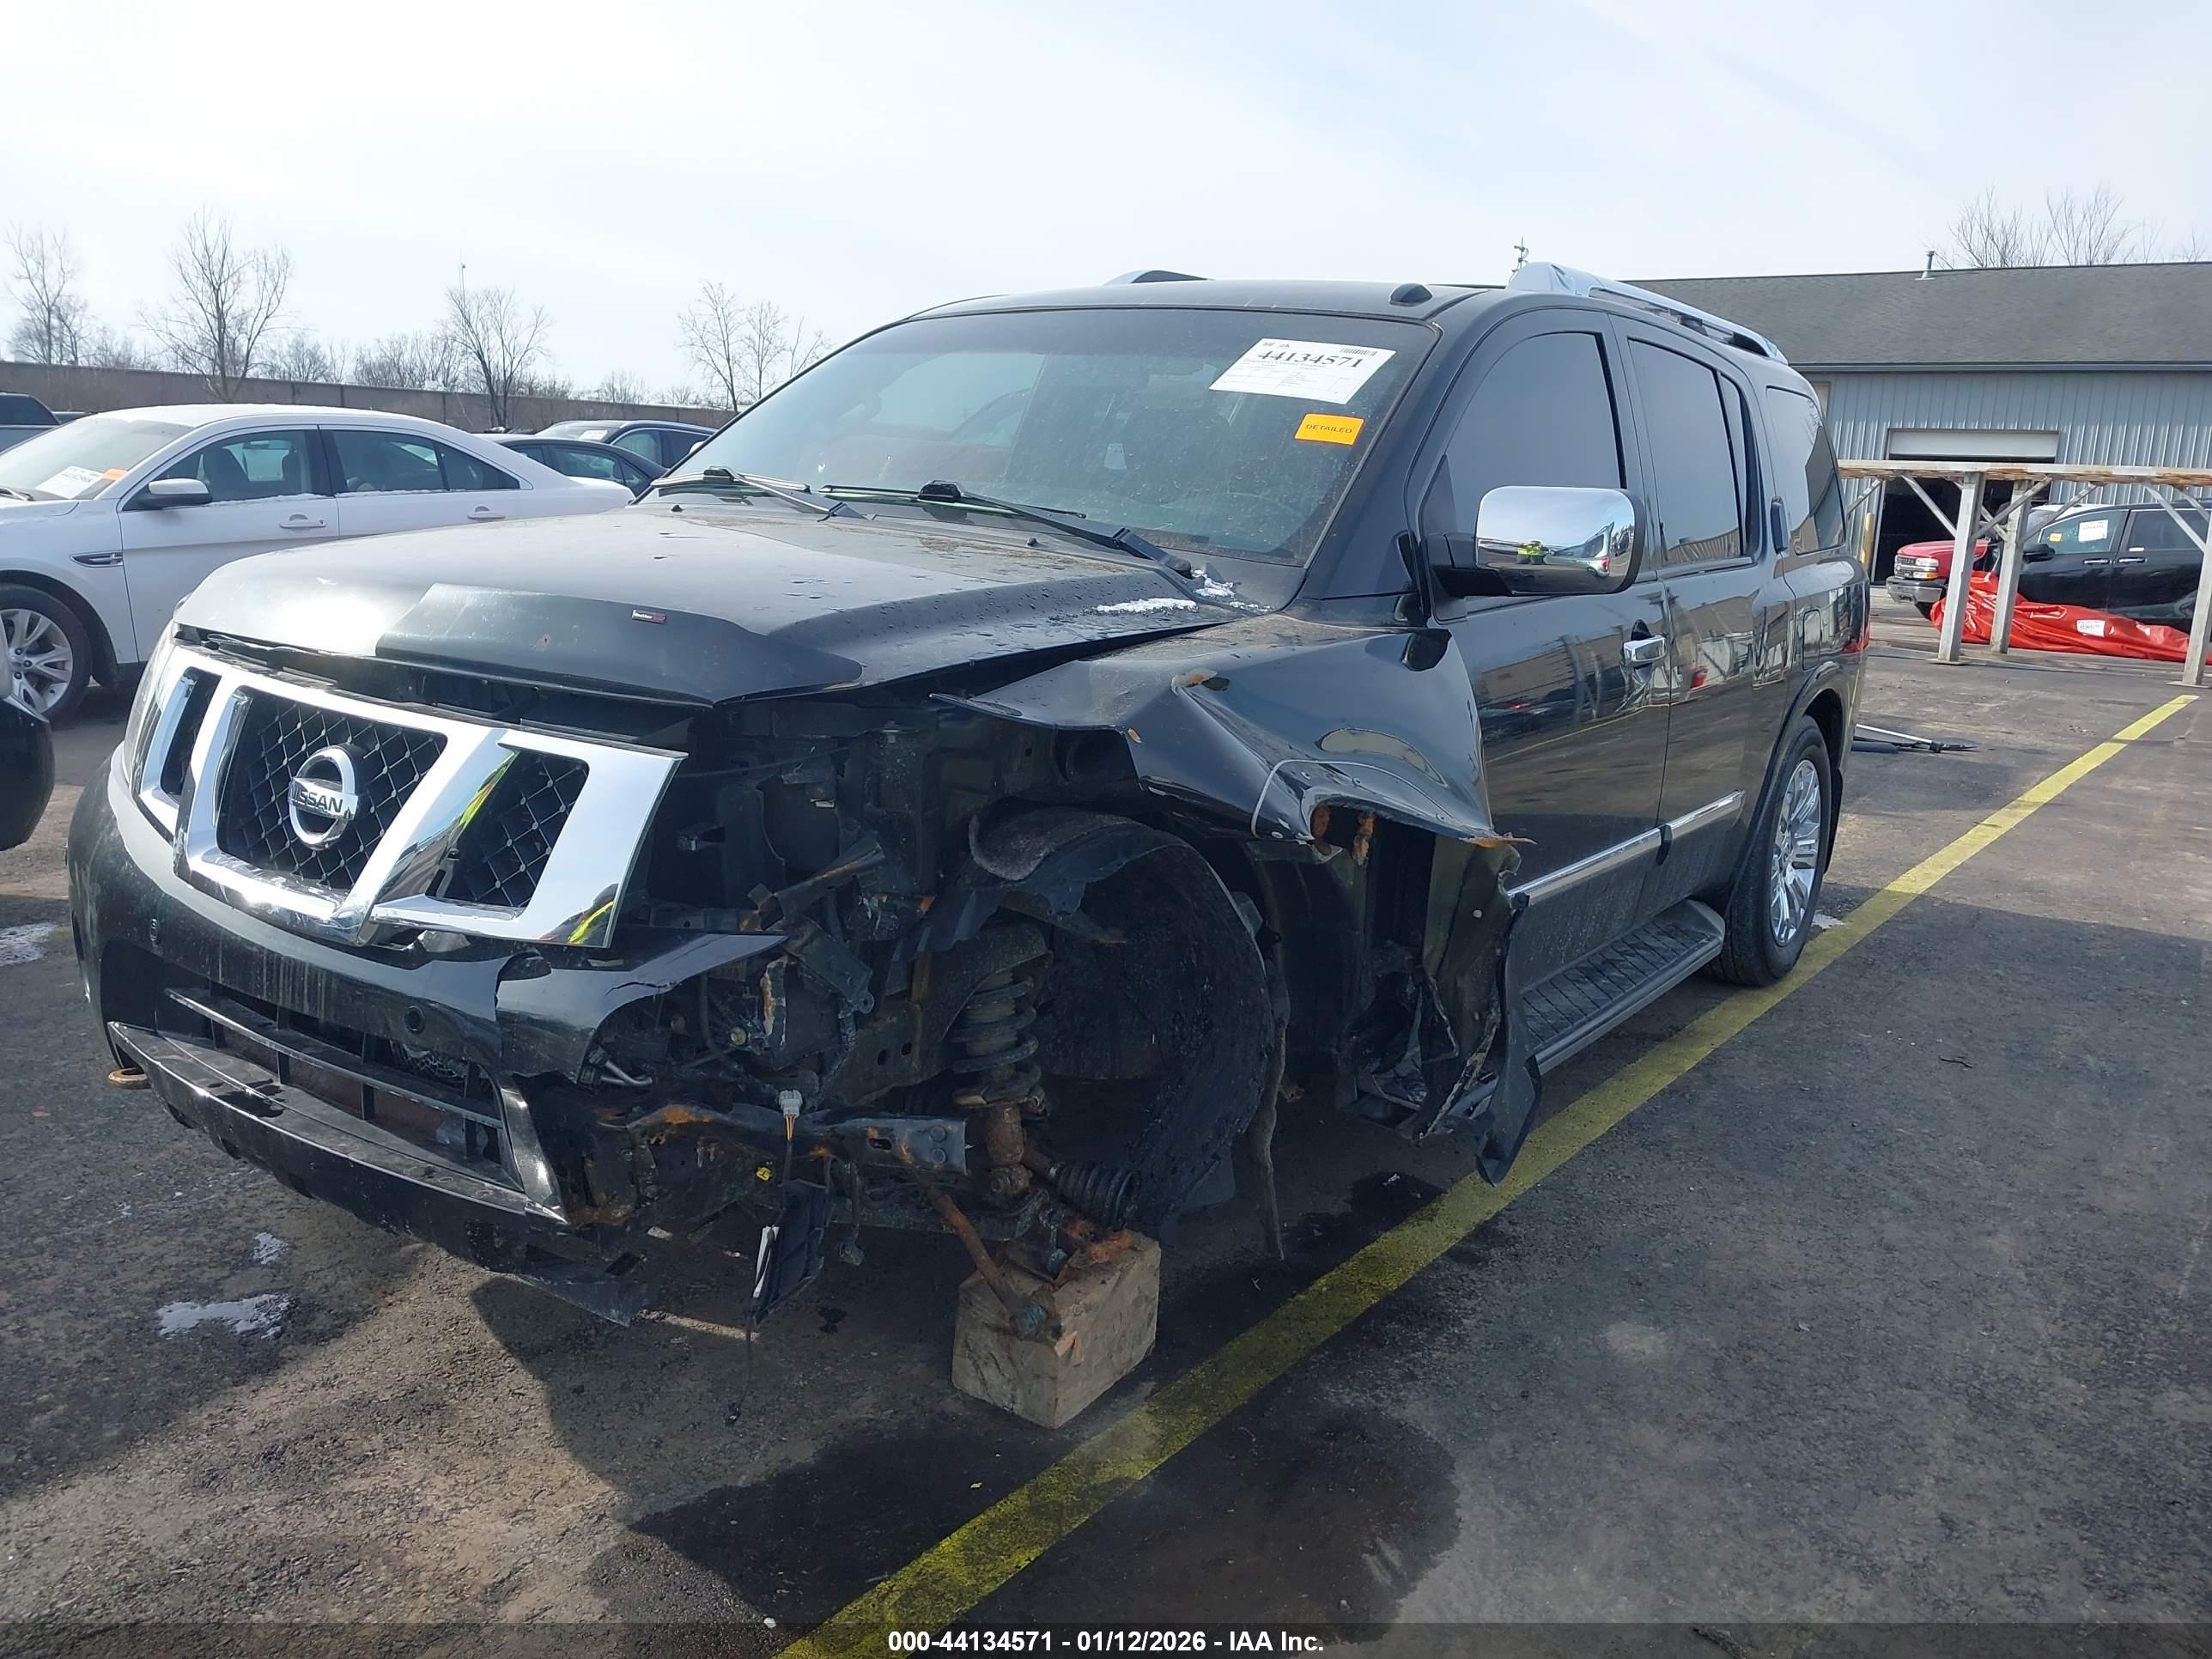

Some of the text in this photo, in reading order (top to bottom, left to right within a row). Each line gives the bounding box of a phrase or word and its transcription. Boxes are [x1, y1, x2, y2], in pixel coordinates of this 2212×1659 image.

[1258, 350, 1364, 368] 44134571
[1304, 423, 1352, 434] DETAILED
[289, 782, 343, 813] NISSAN
